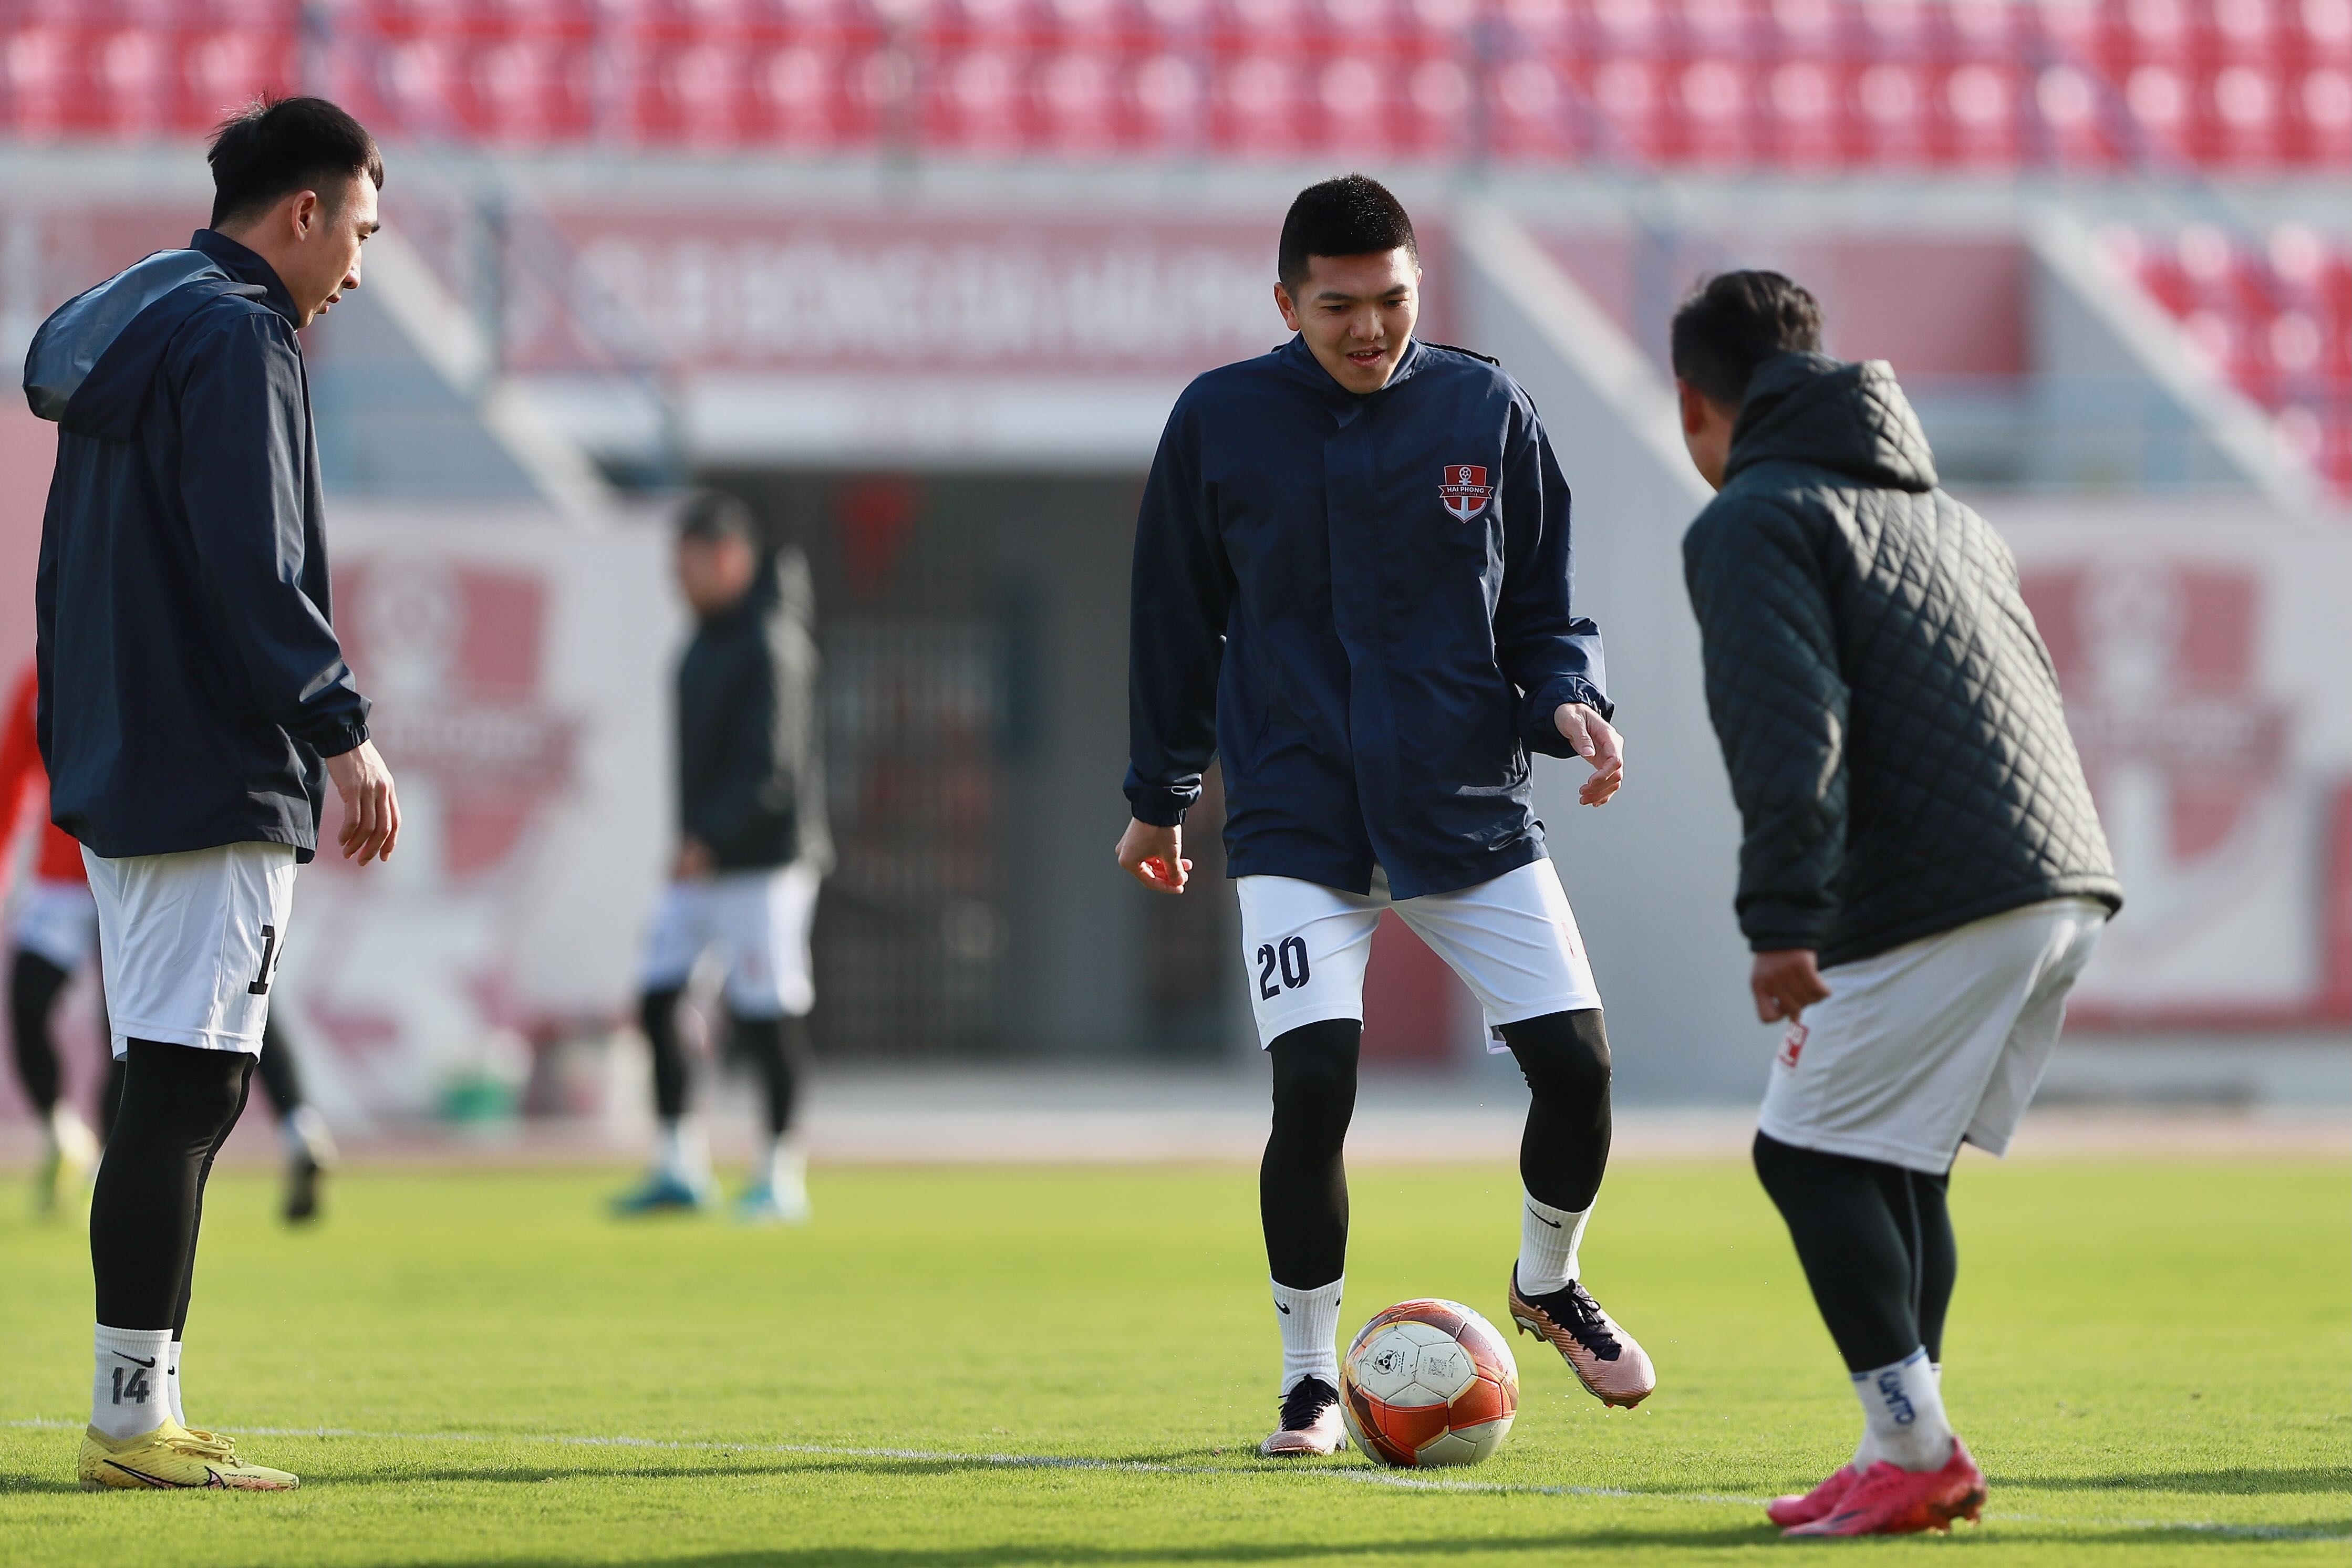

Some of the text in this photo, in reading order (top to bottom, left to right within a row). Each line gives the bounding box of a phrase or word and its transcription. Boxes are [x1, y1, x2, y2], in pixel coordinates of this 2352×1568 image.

[247, 925, 285, 995] 1
[1257, 936, 1310, 1001] 20
[112, 1367, 150, 1405] 14
